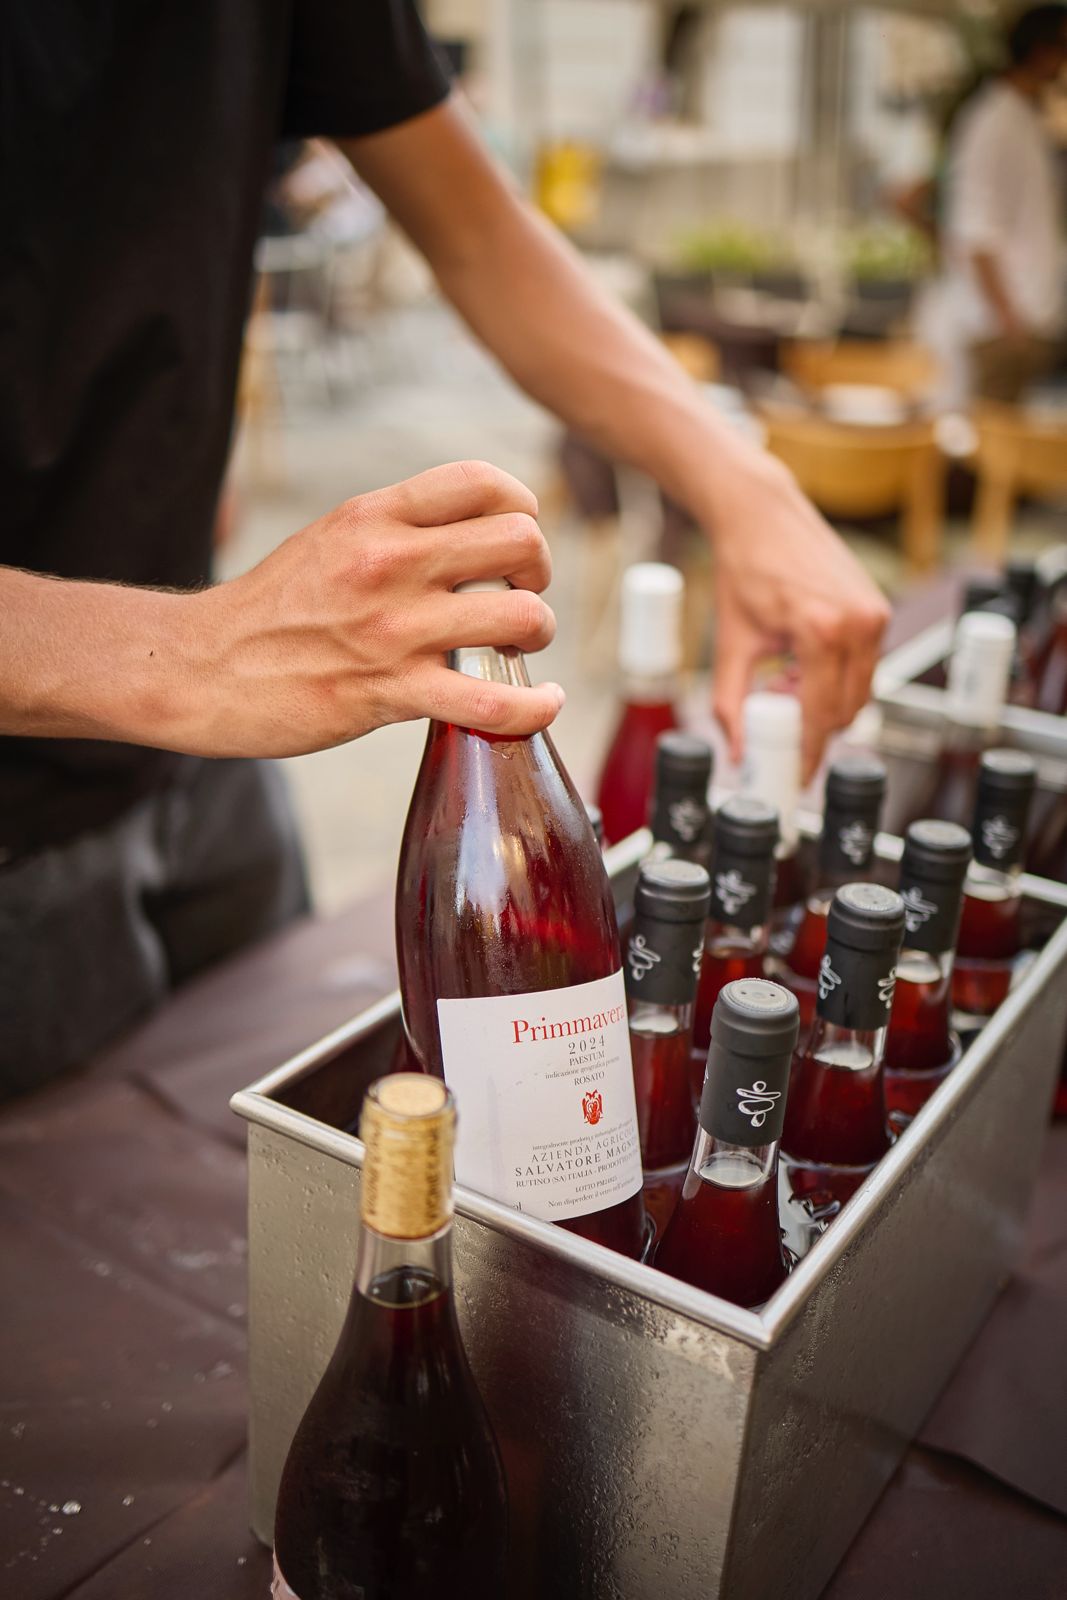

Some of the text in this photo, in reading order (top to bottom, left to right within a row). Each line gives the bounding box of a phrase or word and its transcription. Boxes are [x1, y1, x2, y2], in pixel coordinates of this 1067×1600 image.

[568, 1034, 605, 1054] 2024
[569, 1051, 605, 1066] PAESTUM
[574, 1071, 605, 1086] ROSATO
[531, 1144, 591, 1163] AZIENDA
[515, 1153, 601, 1177] SALVATORE
[516, 1177, 550, 1188] RUTINO
[568, 1168, 593, 1183] ITALIA
[575, 1182, 596, 1193] LOTTO
[548, 1199, 562, 1208] Non
